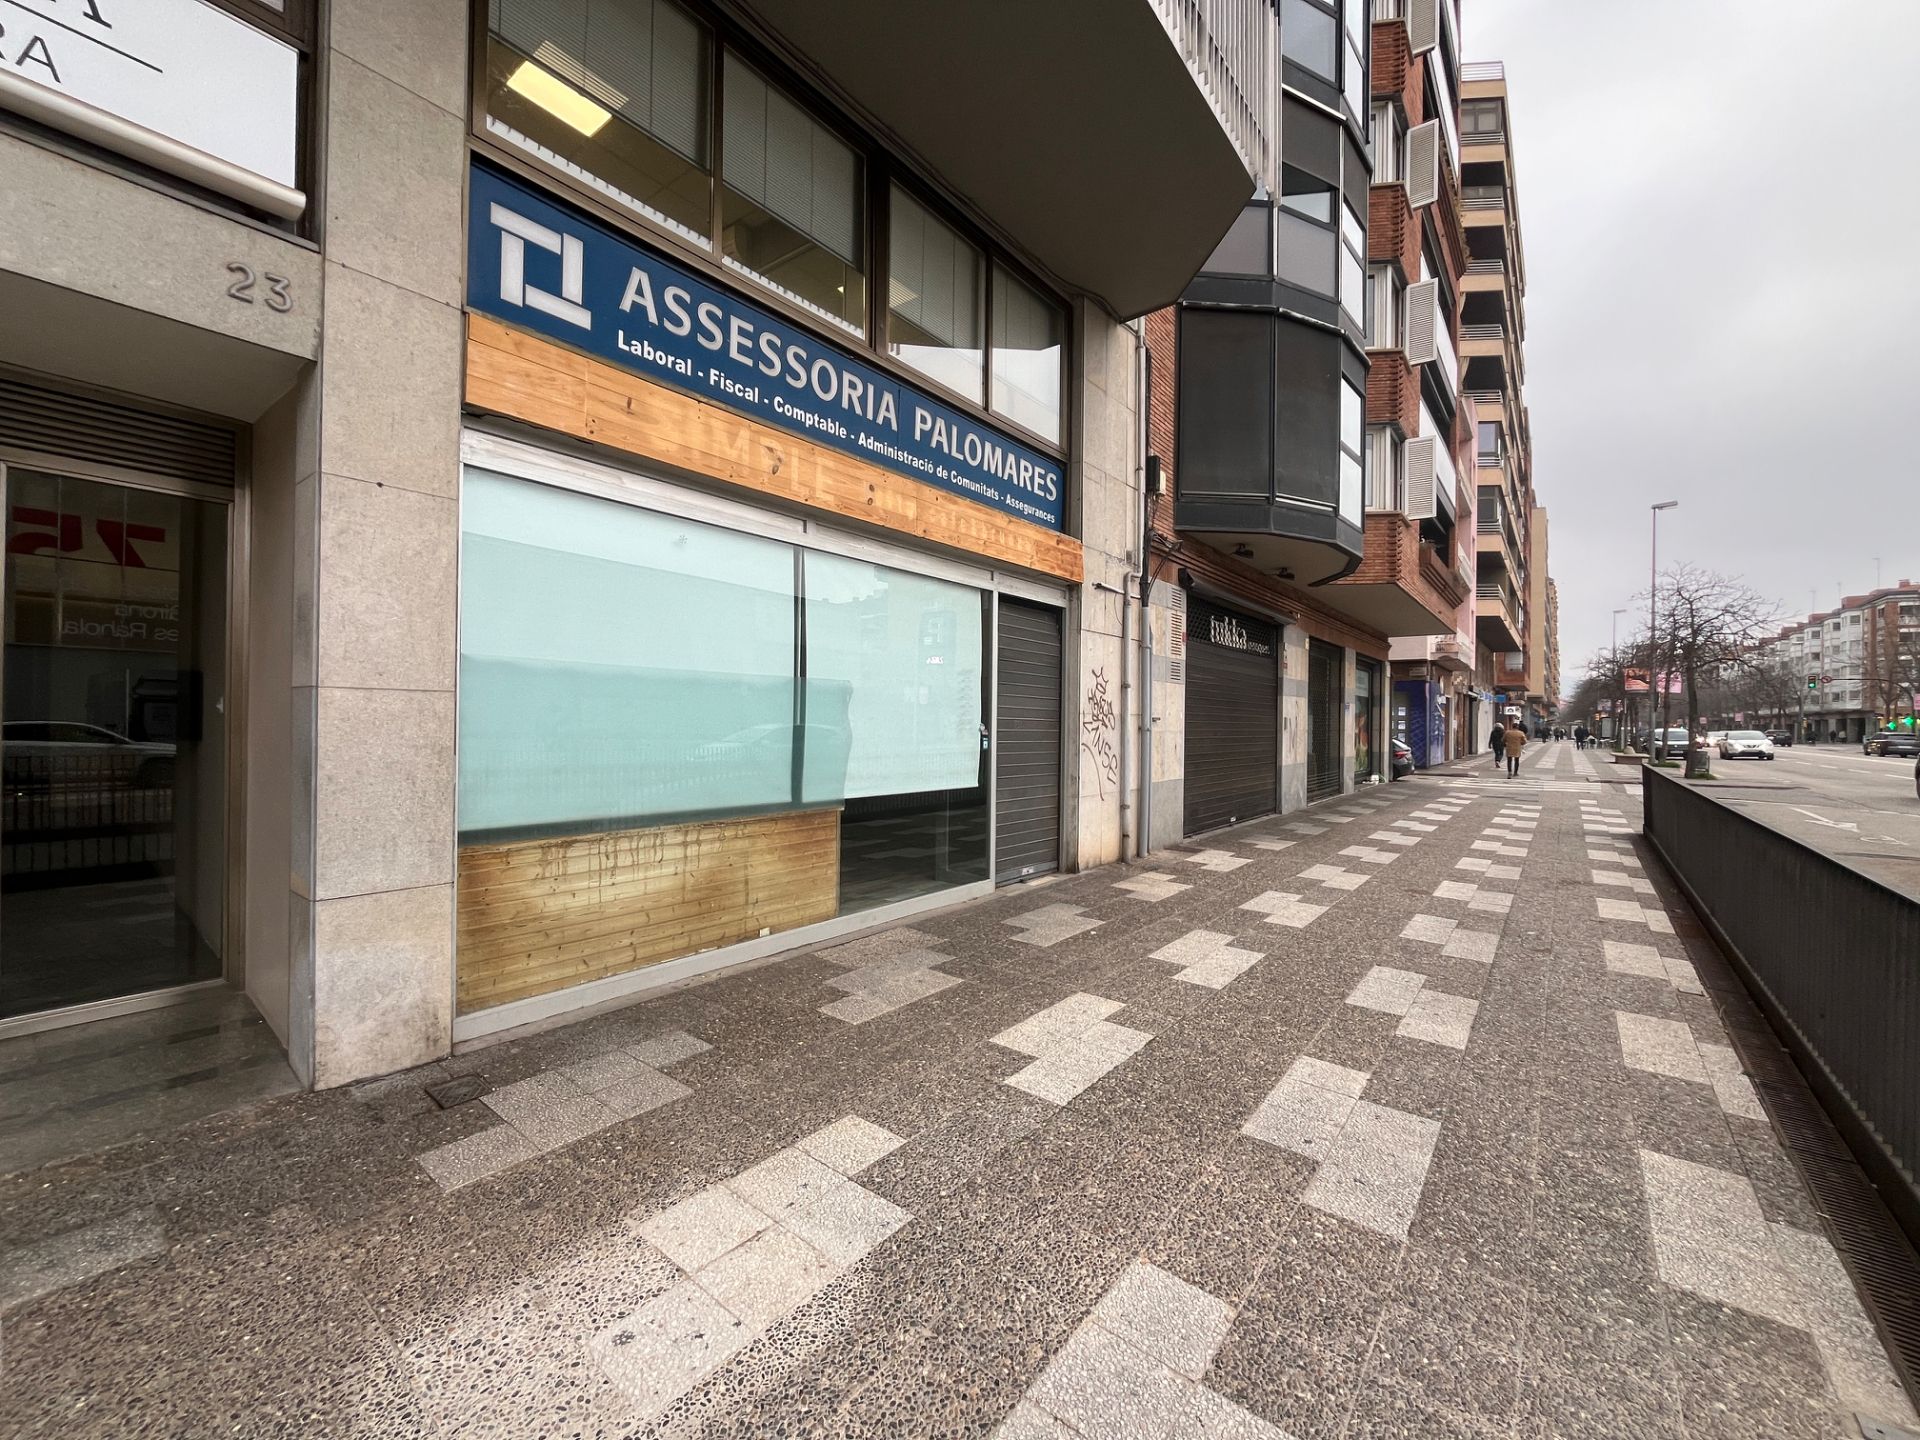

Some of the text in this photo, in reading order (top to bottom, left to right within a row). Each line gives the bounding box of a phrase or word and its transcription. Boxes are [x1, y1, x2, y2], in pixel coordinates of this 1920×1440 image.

[0, 22, 61, 84] A
[226, 261, 294, 313] 23
[618, 329, 692, 376] Laboral
[709, 368, 759, 404] Fiscal
[773, 396, 847, 438] Comptable
[858, 432, 934, 475] Administració
[936, 465, 949, 480] de
[950, 470, 999, 501] Comunitats
[1005, 494, 1056, 524] Assegurances
[619, 267, 1057, 501] ASSESSORIA PALOMARES
